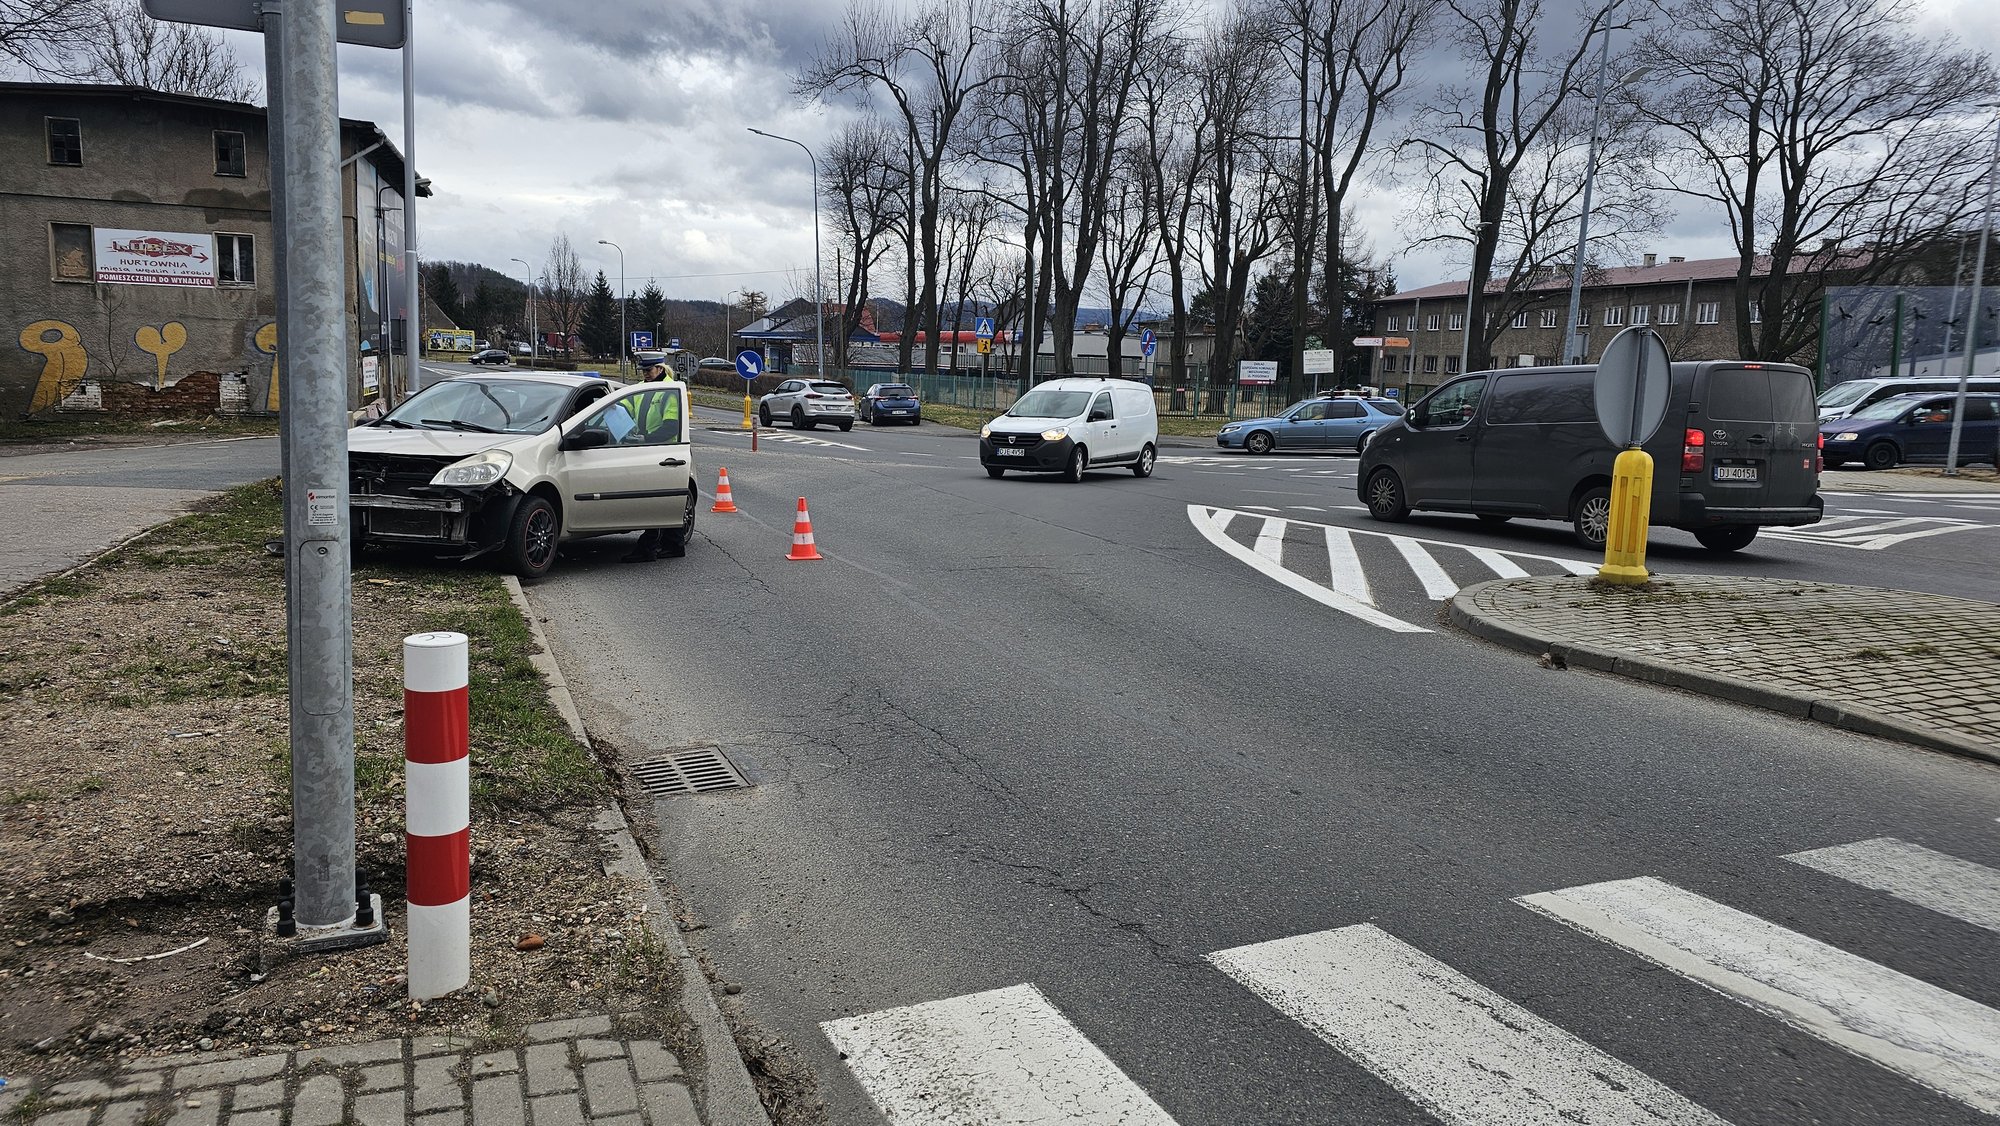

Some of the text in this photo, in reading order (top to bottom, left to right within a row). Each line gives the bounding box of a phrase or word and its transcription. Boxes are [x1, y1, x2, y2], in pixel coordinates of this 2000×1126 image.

[120, 258, 188, 268] HURTOWNIA
[99, 273, 212, 286] POMIESZCZENIA DO WYNAJĘCIA
[1719, 468, 1756, 479] DJ 4015A
